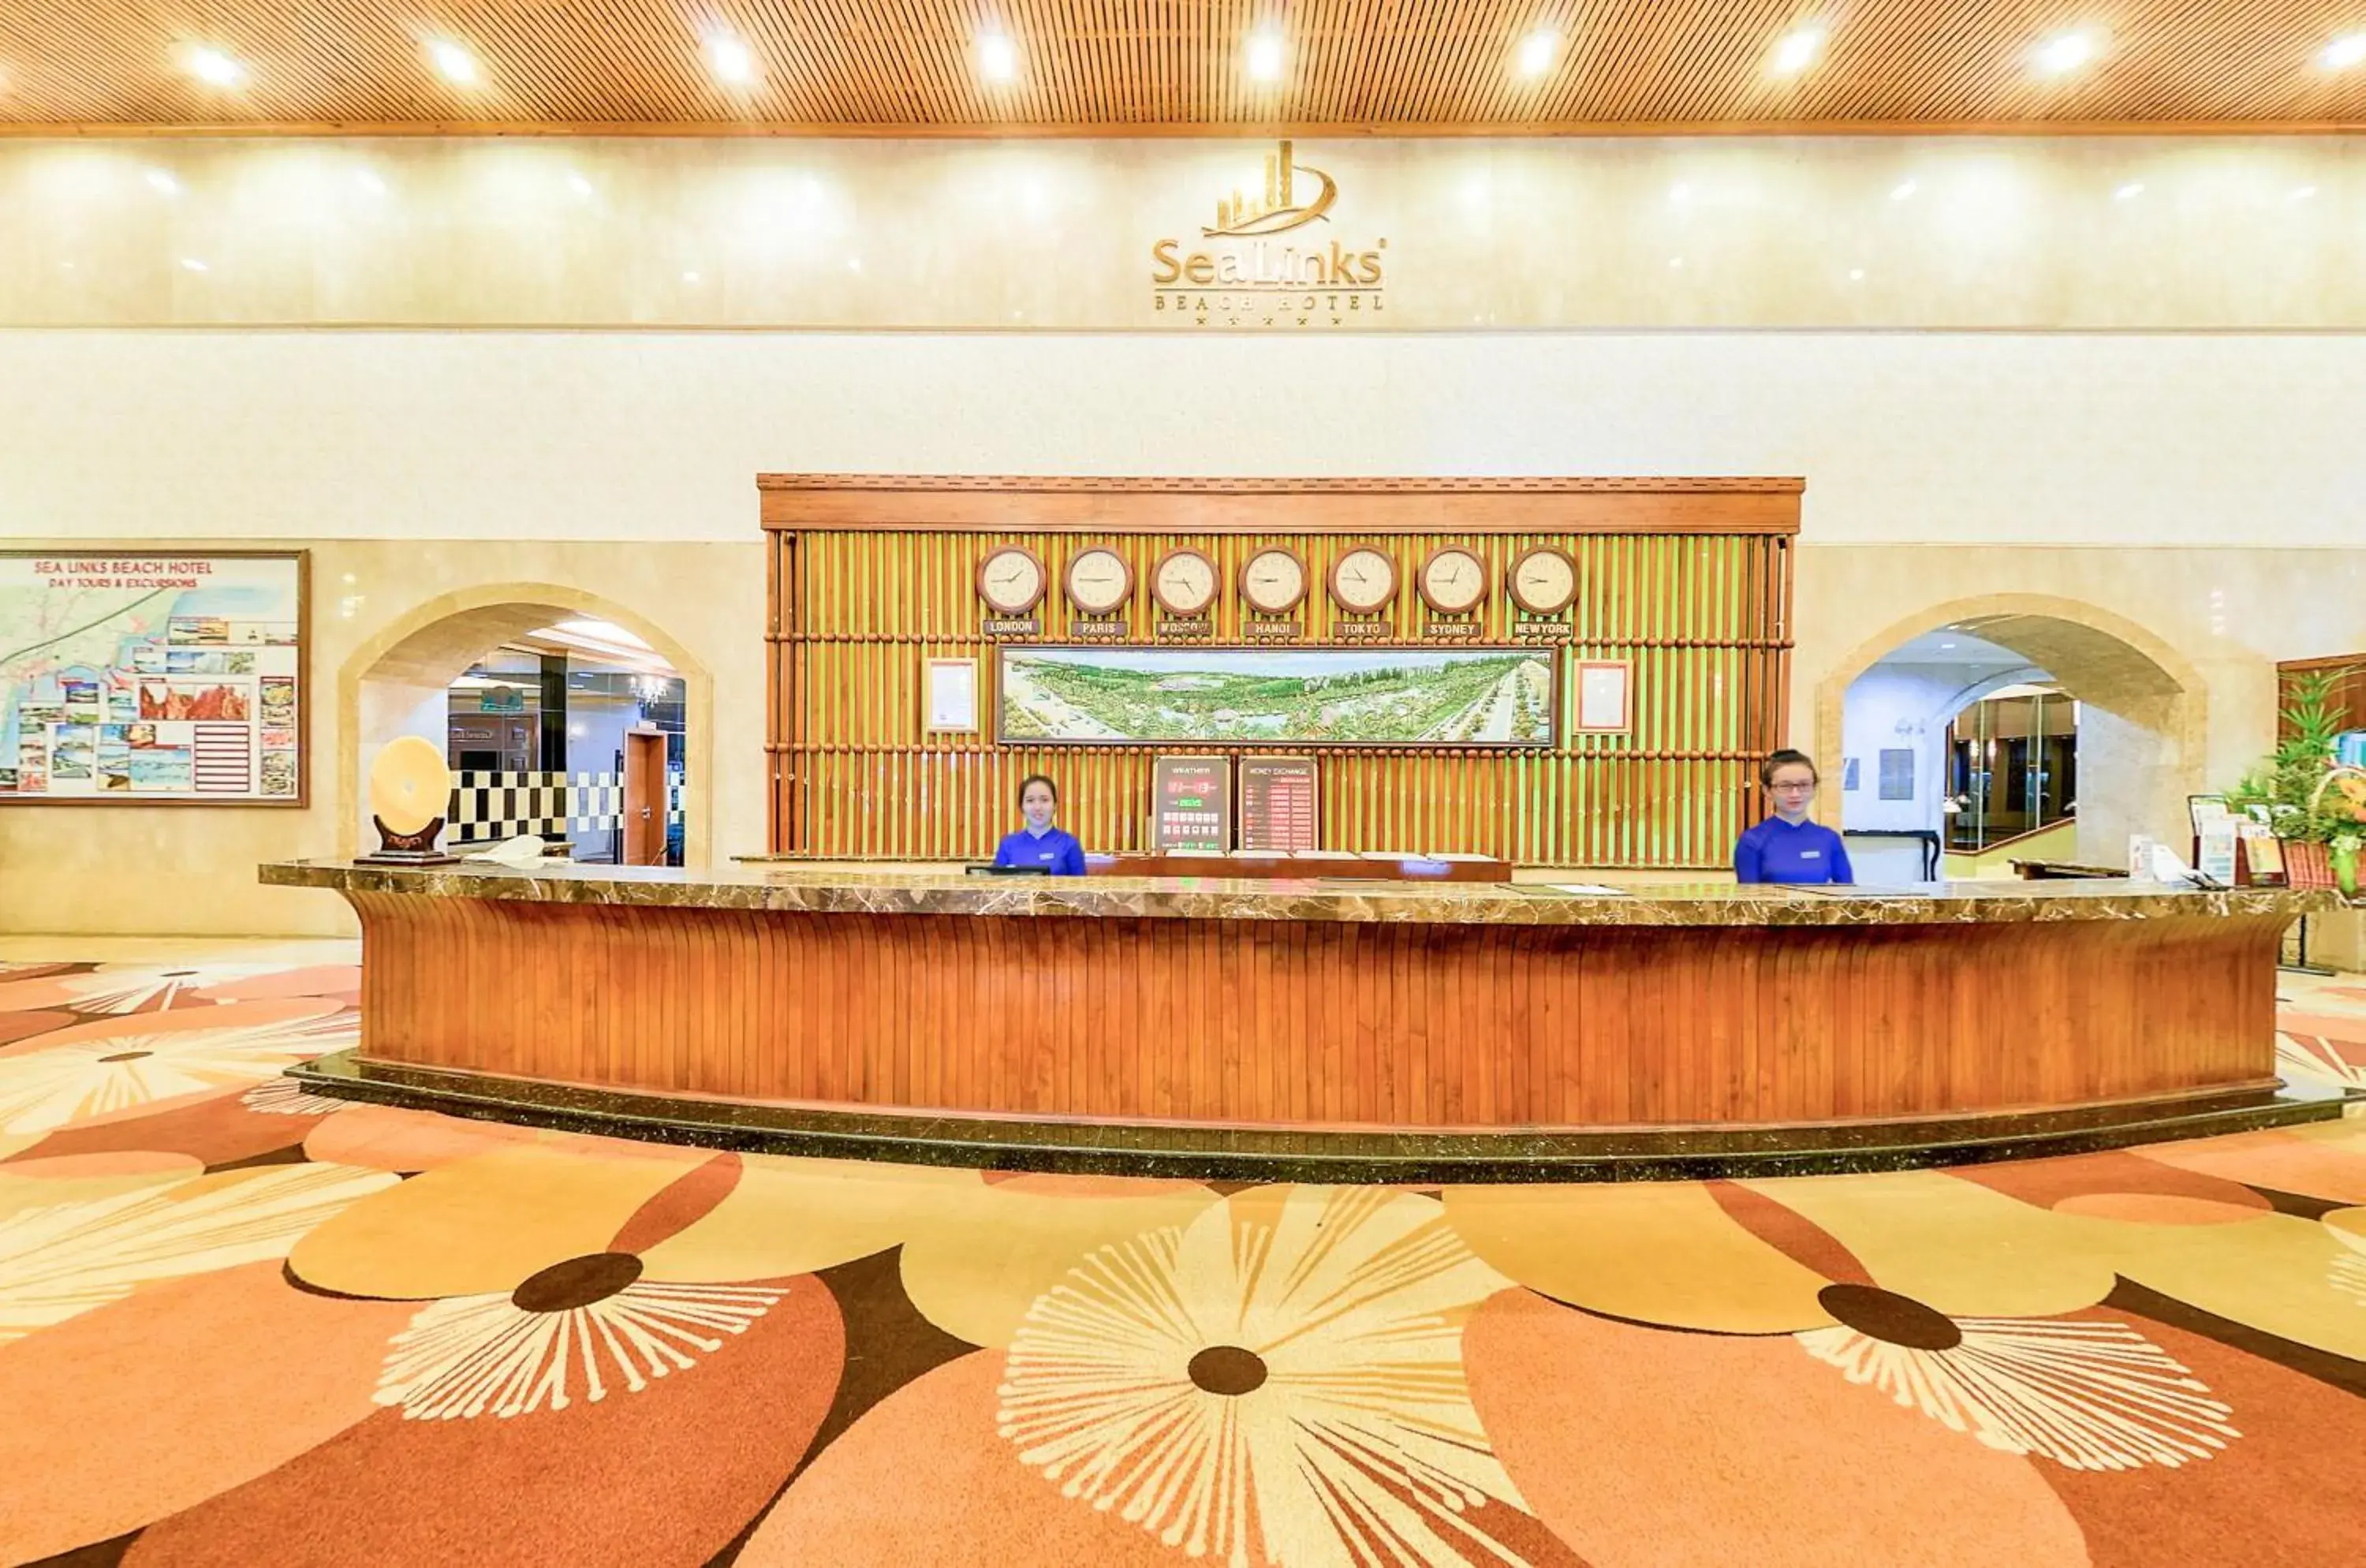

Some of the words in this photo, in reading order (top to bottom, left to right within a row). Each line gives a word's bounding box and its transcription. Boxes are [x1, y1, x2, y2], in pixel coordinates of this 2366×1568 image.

[35, 562, 62, 573] SEA
[68, 562, 107, 573] LINKS
[112, 562, 162, 573] BEACH
[168, 562, 212, 573] HOTEL
[49, 578, 72, 588] DAY
[77, 578, 110, 588] TOURS
[126, 578, 197, 588] EXCURSIONS
[991, 621, 1033, 632] LONDON
[1083, 623, 1116, 633] PARIS
[1256, 624, 1290, 633] HANOI
[1344, 624, 1380, 633] TOKYO
[1430, 624, 1475, 634] SYDNEY
